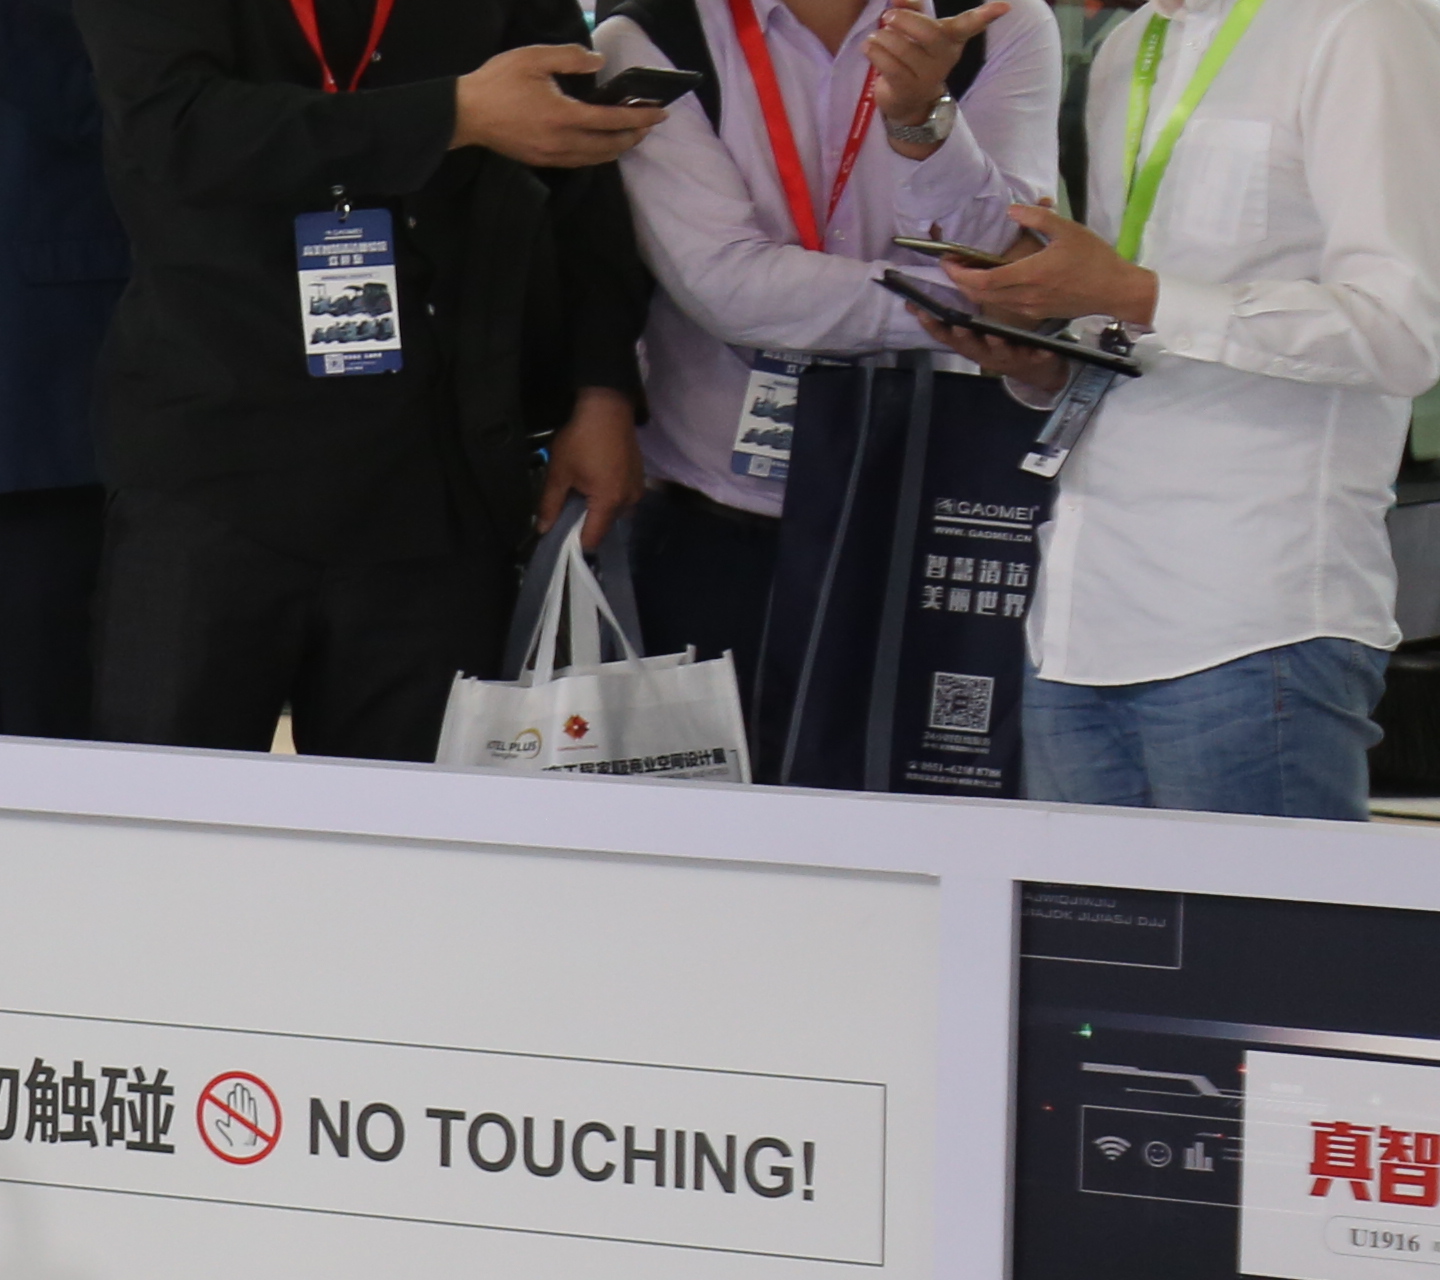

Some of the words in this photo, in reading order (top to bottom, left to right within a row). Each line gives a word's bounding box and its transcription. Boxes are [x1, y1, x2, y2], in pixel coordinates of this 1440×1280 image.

[956, 501, 1034, 521] GAOMEI
[925, 554, 1031, 588] 智慧清洁
[921, 584, 1026, 618] 美丽世界
[308, 1096, 406, 1164] NO
[425, 1106, 818, 1204] TOUCHING!
[1349, 1226, 1421, 1254] U1916
